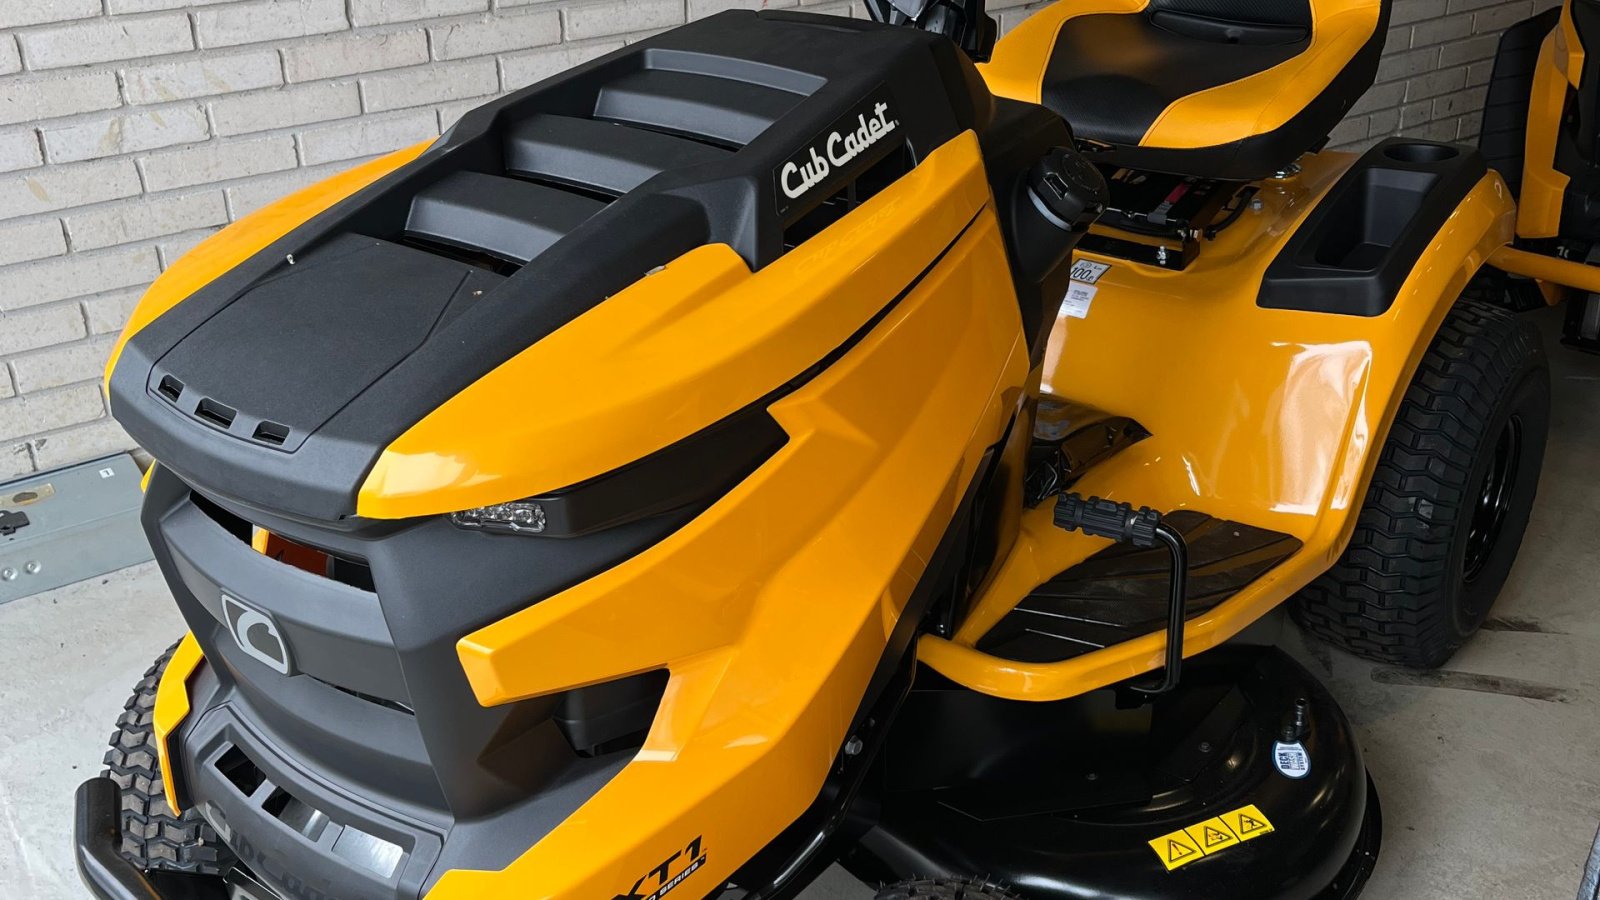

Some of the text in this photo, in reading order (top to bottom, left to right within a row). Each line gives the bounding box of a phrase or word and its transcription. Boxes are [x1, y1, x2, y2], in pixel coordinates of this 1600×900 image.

[780, 102, 896, 199] Cub Cadet
[659, 860, 699, 897] SERIES
